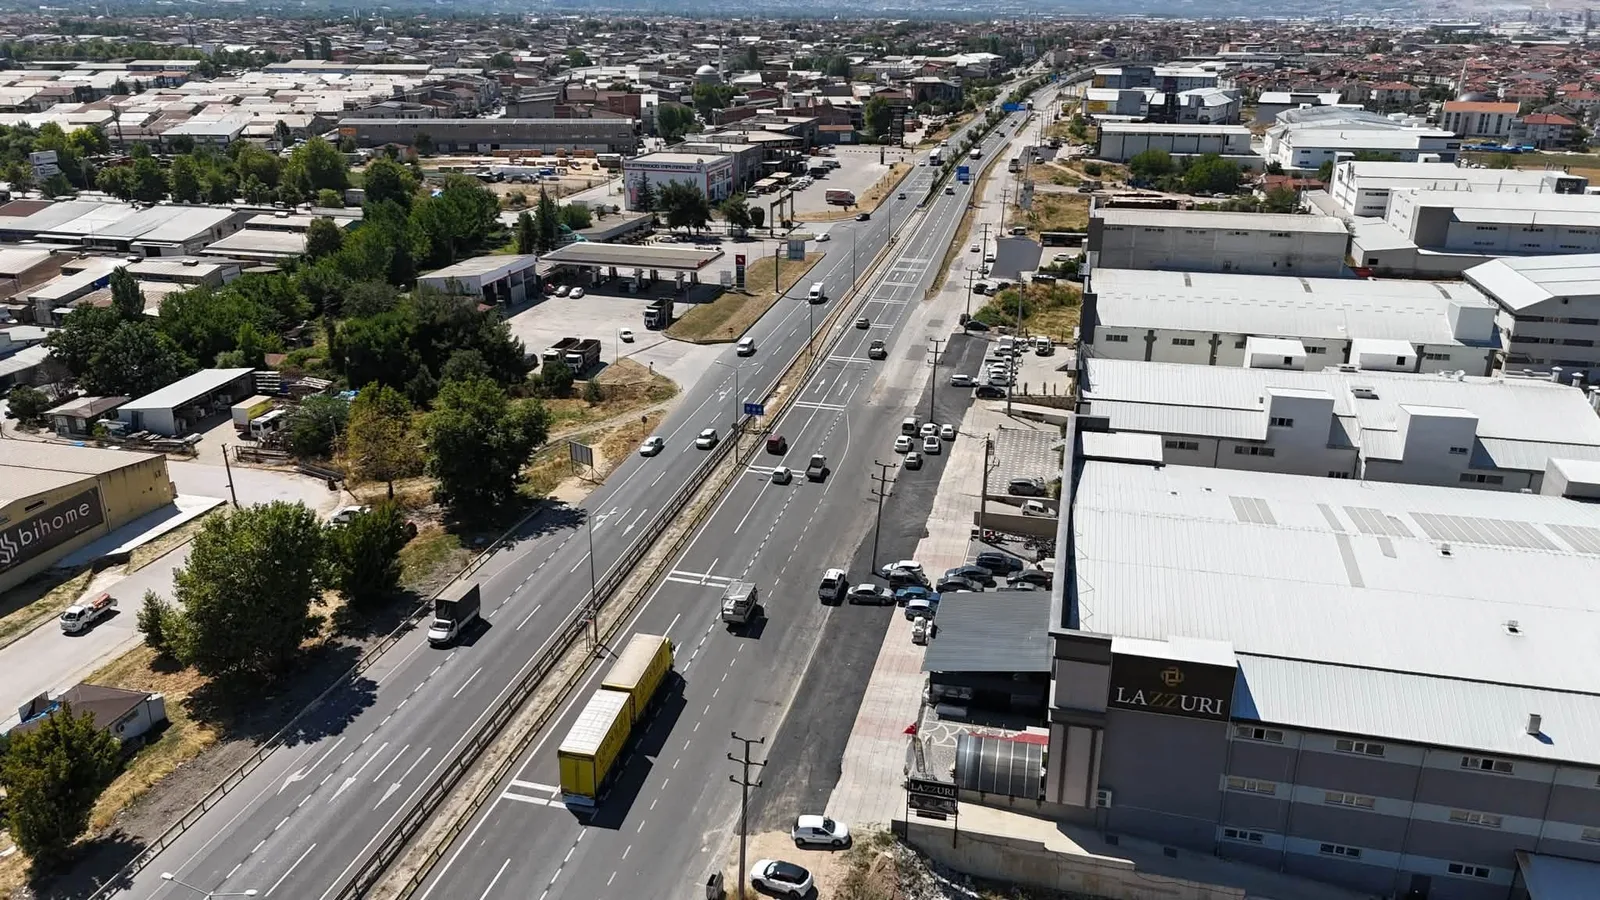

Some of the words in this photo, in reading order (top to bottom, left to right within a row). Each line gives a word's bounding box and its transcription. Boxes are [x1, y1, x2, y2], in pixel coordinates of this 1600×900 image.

[18, 503, 90, 546] bihome
[1116, 687, 1223, 715] LAZZURI
[911, 783, 954, 796] LAZZURI
